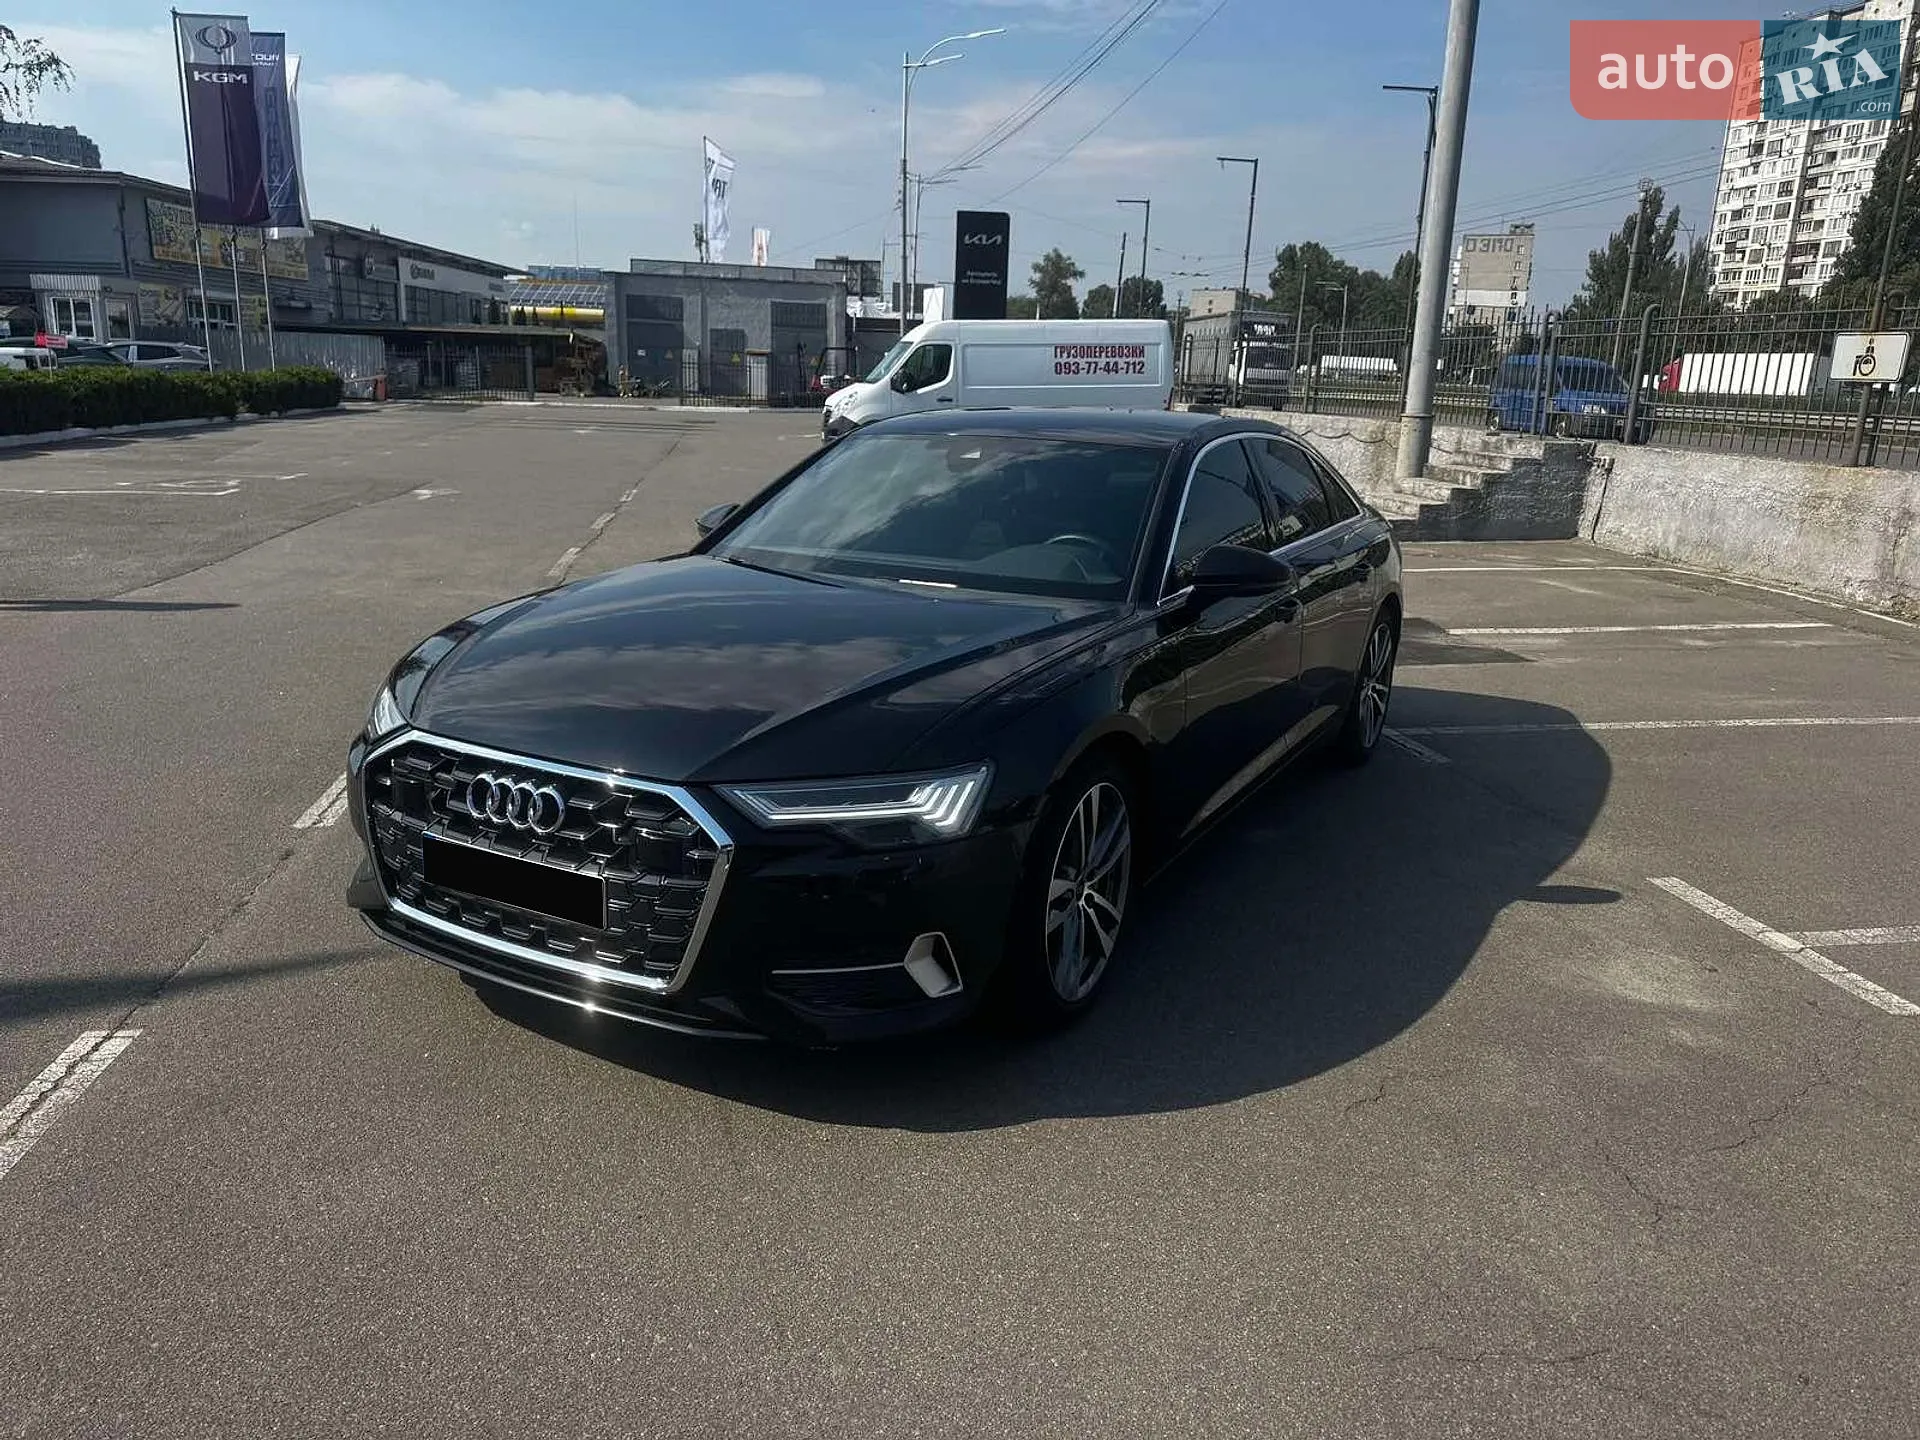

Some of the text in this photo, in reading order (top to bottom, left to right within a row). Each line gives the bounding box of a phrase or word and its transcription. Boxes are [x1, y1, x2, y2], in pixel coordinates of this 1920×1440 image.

[193, 71, 248, 84] KGM
[1054, 345, 1145, 359] ГРУЗОПЕРЕВОЗКИ
[1054, 360, 1145, 375] 093-77-44-712
